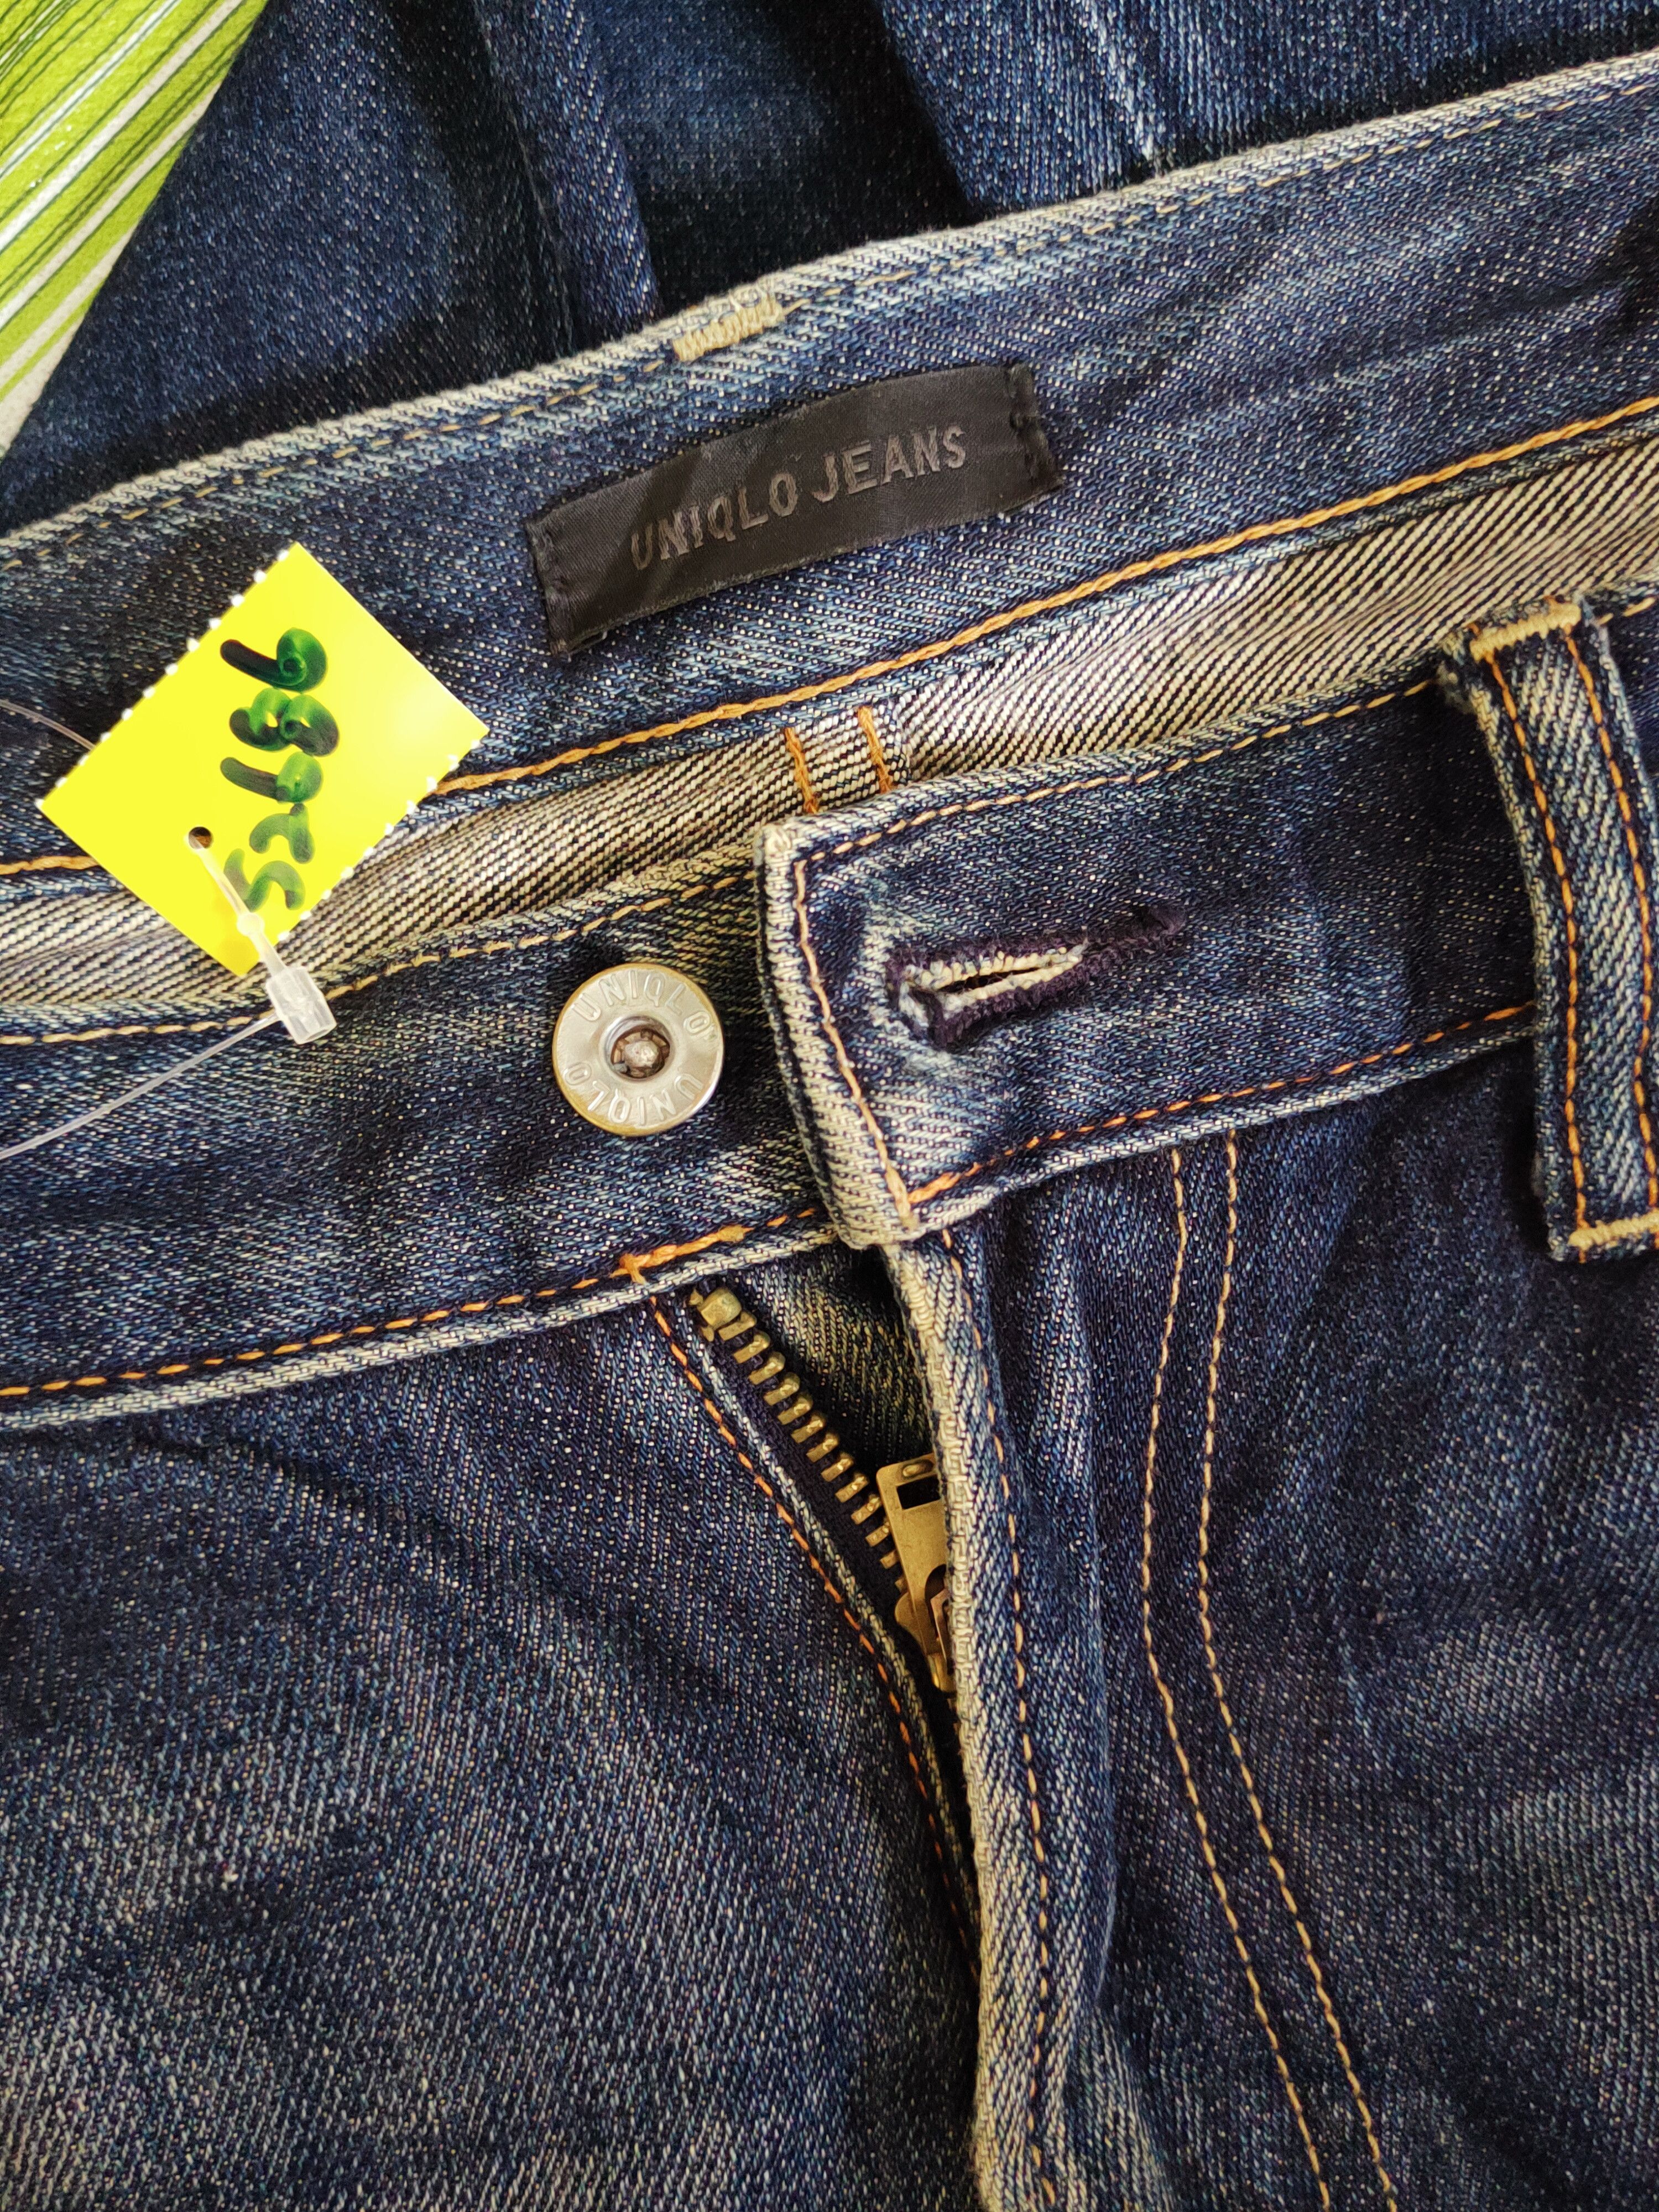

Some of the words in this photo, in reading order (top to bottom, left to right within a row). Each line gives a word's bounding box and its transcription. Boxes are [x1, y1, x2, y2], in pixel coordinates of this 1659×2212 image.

[629, 471, 799, 571] UNIQLO
[812, 425, 968, 503] JEANS
[571, 969, 712, 1036] UNIQLO
[562, 1062, 705, 1126] UNIQLO
